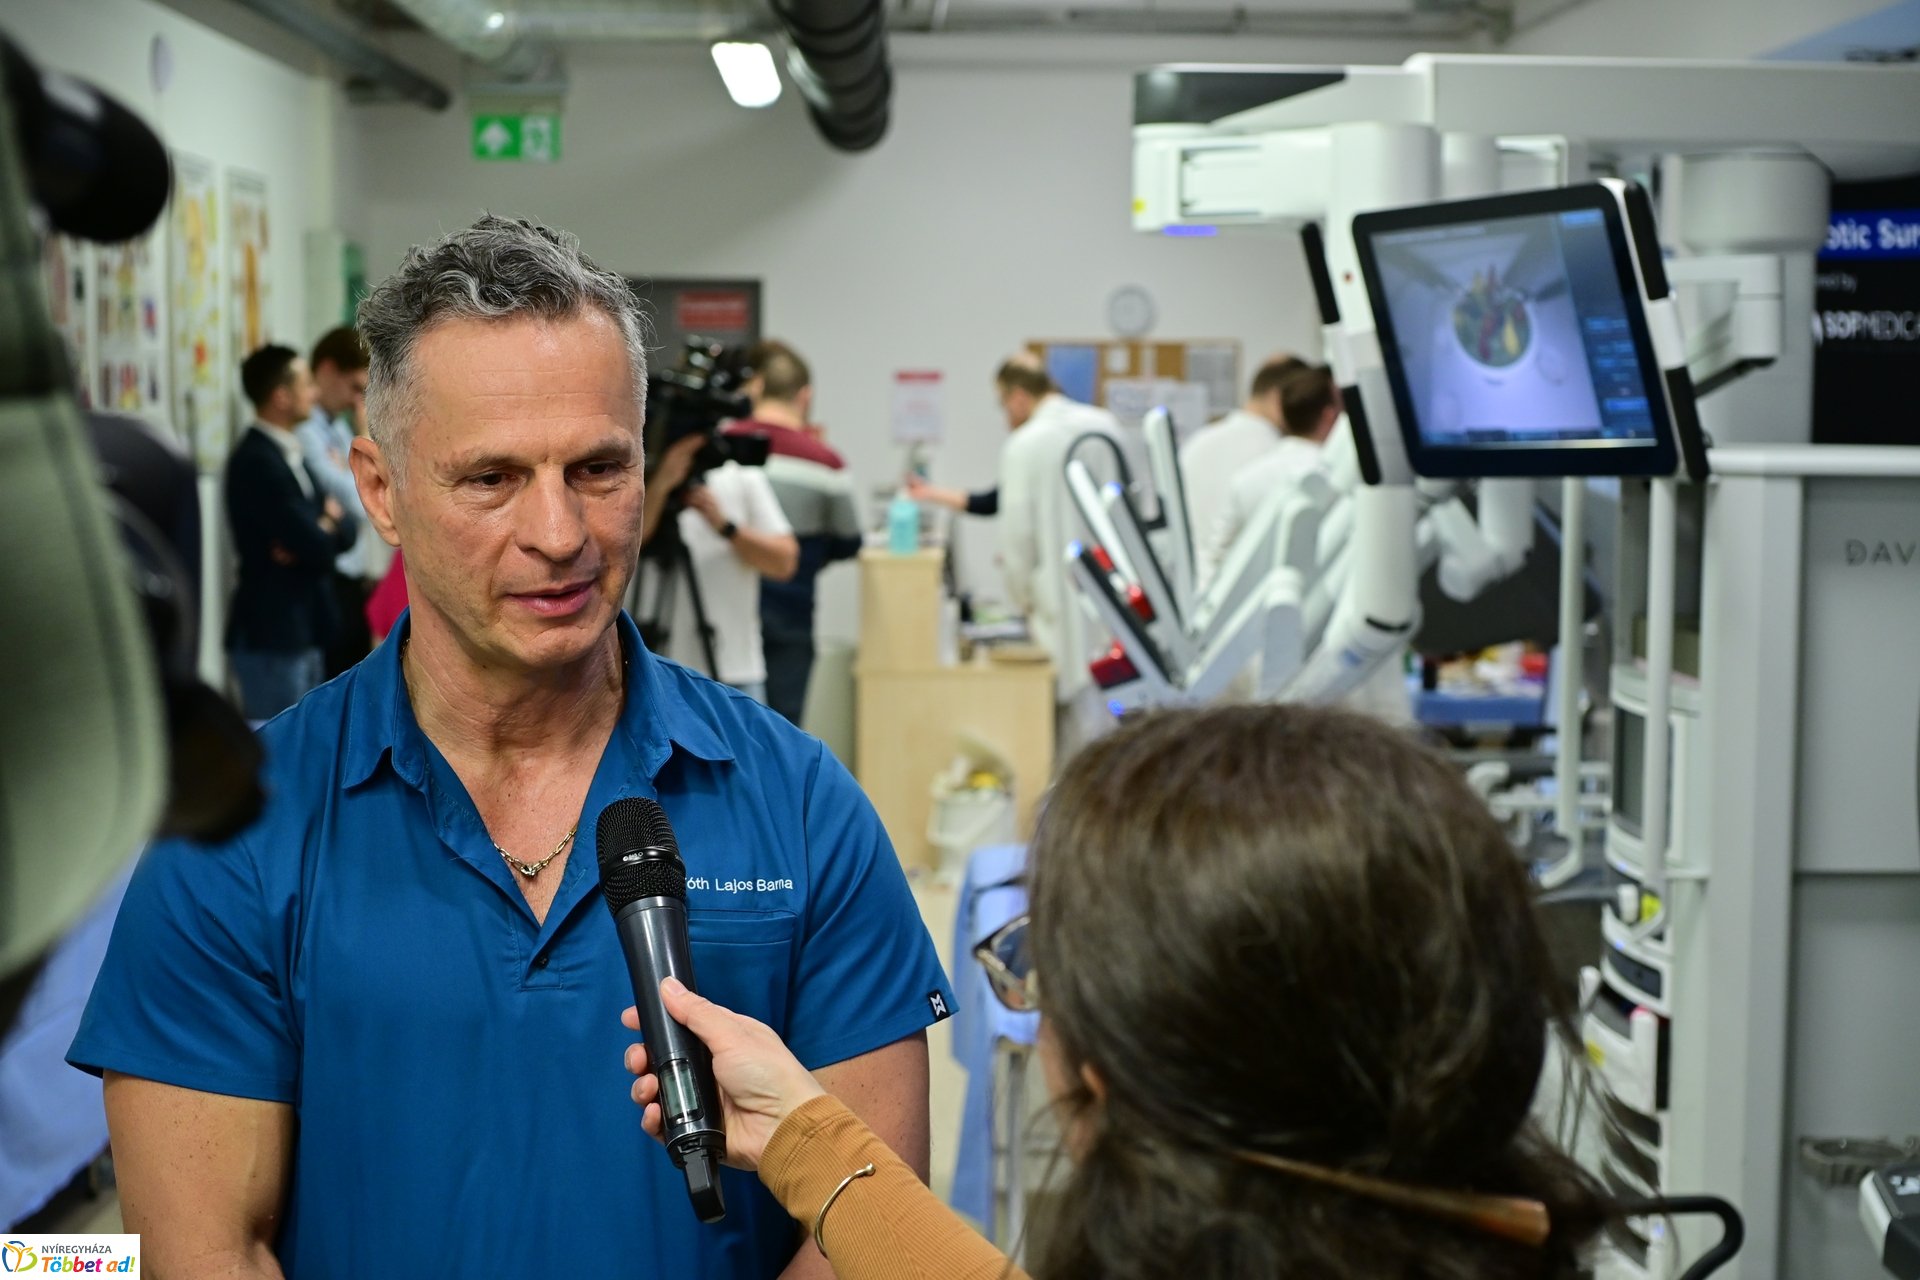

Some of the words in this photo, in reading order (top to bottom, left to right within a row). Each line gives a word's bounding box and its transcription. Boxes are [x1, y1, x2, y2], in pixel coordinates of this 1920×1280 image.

[684, 877, 710, 890] óth
[715, 878, 753, 894] Lajos
[756, 878, 793, 892] Barna
